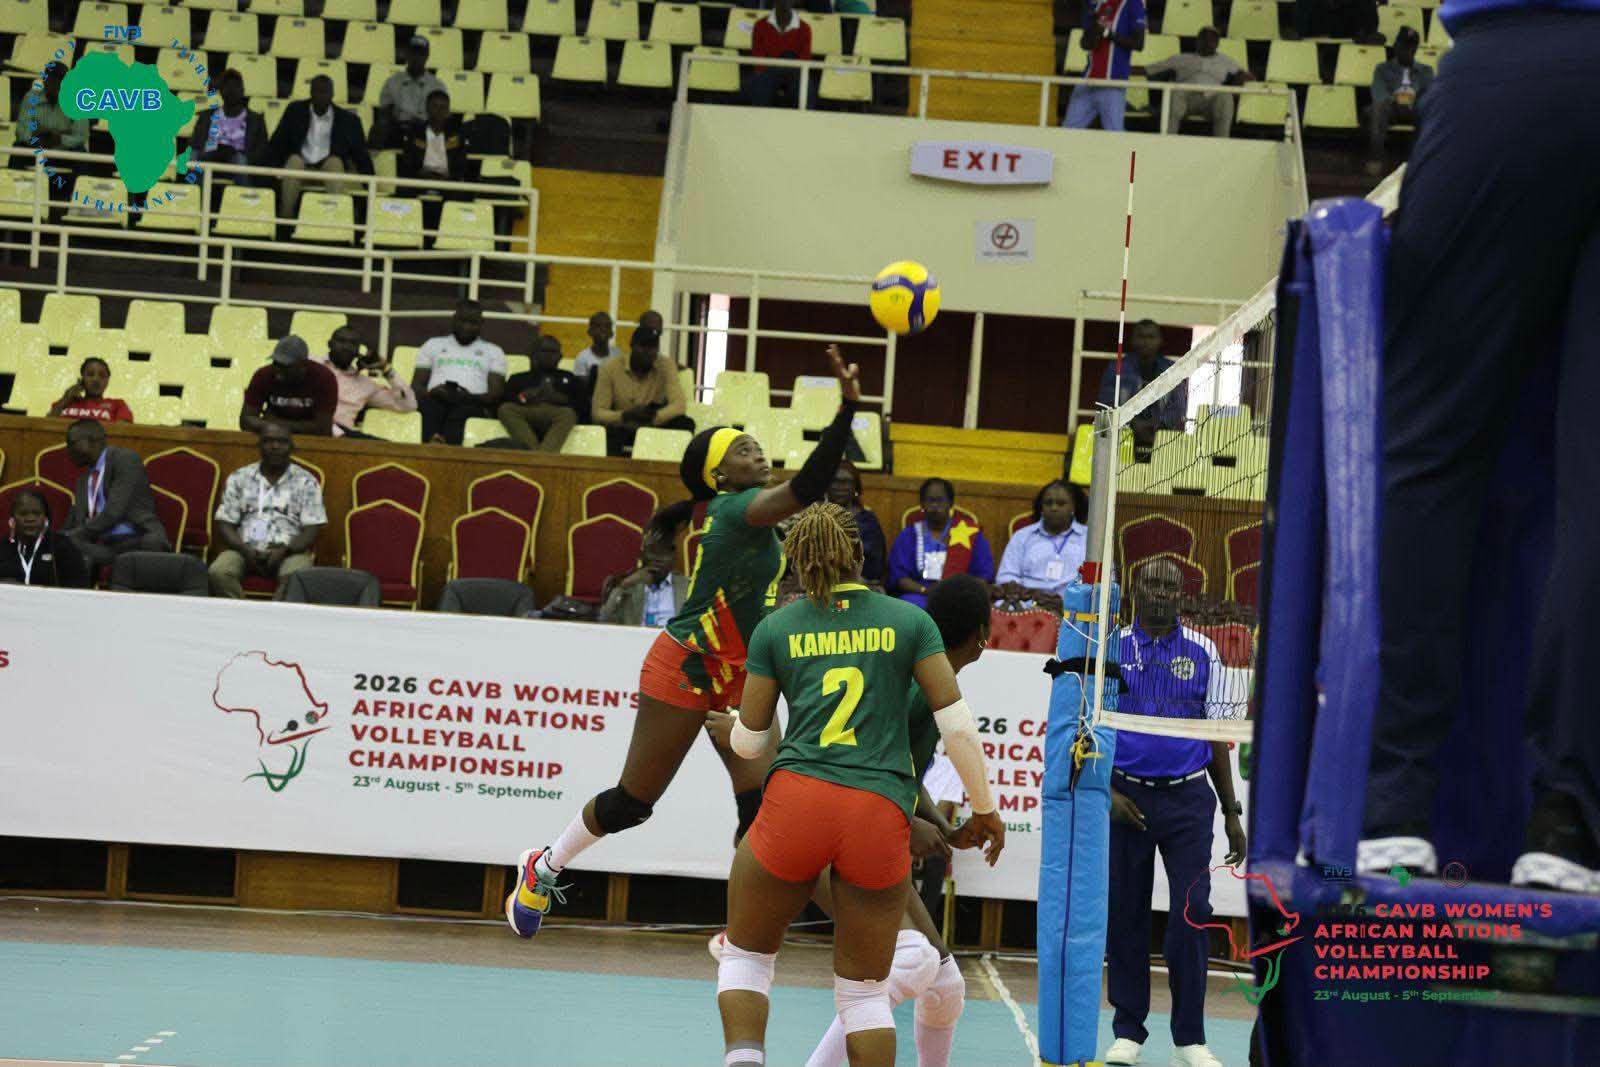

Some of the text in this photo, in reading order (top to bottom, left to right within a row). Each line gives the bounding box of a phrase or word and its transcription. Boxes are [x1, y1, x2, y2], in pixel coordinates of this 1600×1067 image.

[943, 149, 1022, 173] EXIT
[61, 407, 110, 420] KENYA
[788, 627, 895, 658] KAMANDO
[353, 673, 640, 710] 2026 CAVB WOMEN'S
[352, 699, 605, 732] AFRICAN NATIONS
[820, 666, 864, 748] 2
[351, 724, 526, 752] VOLLEYBALL
[349, 750, 563, 779] CHAMPIONSHIP
[384, 778, 440, 793] August
[477, 783, 563, 800] September
